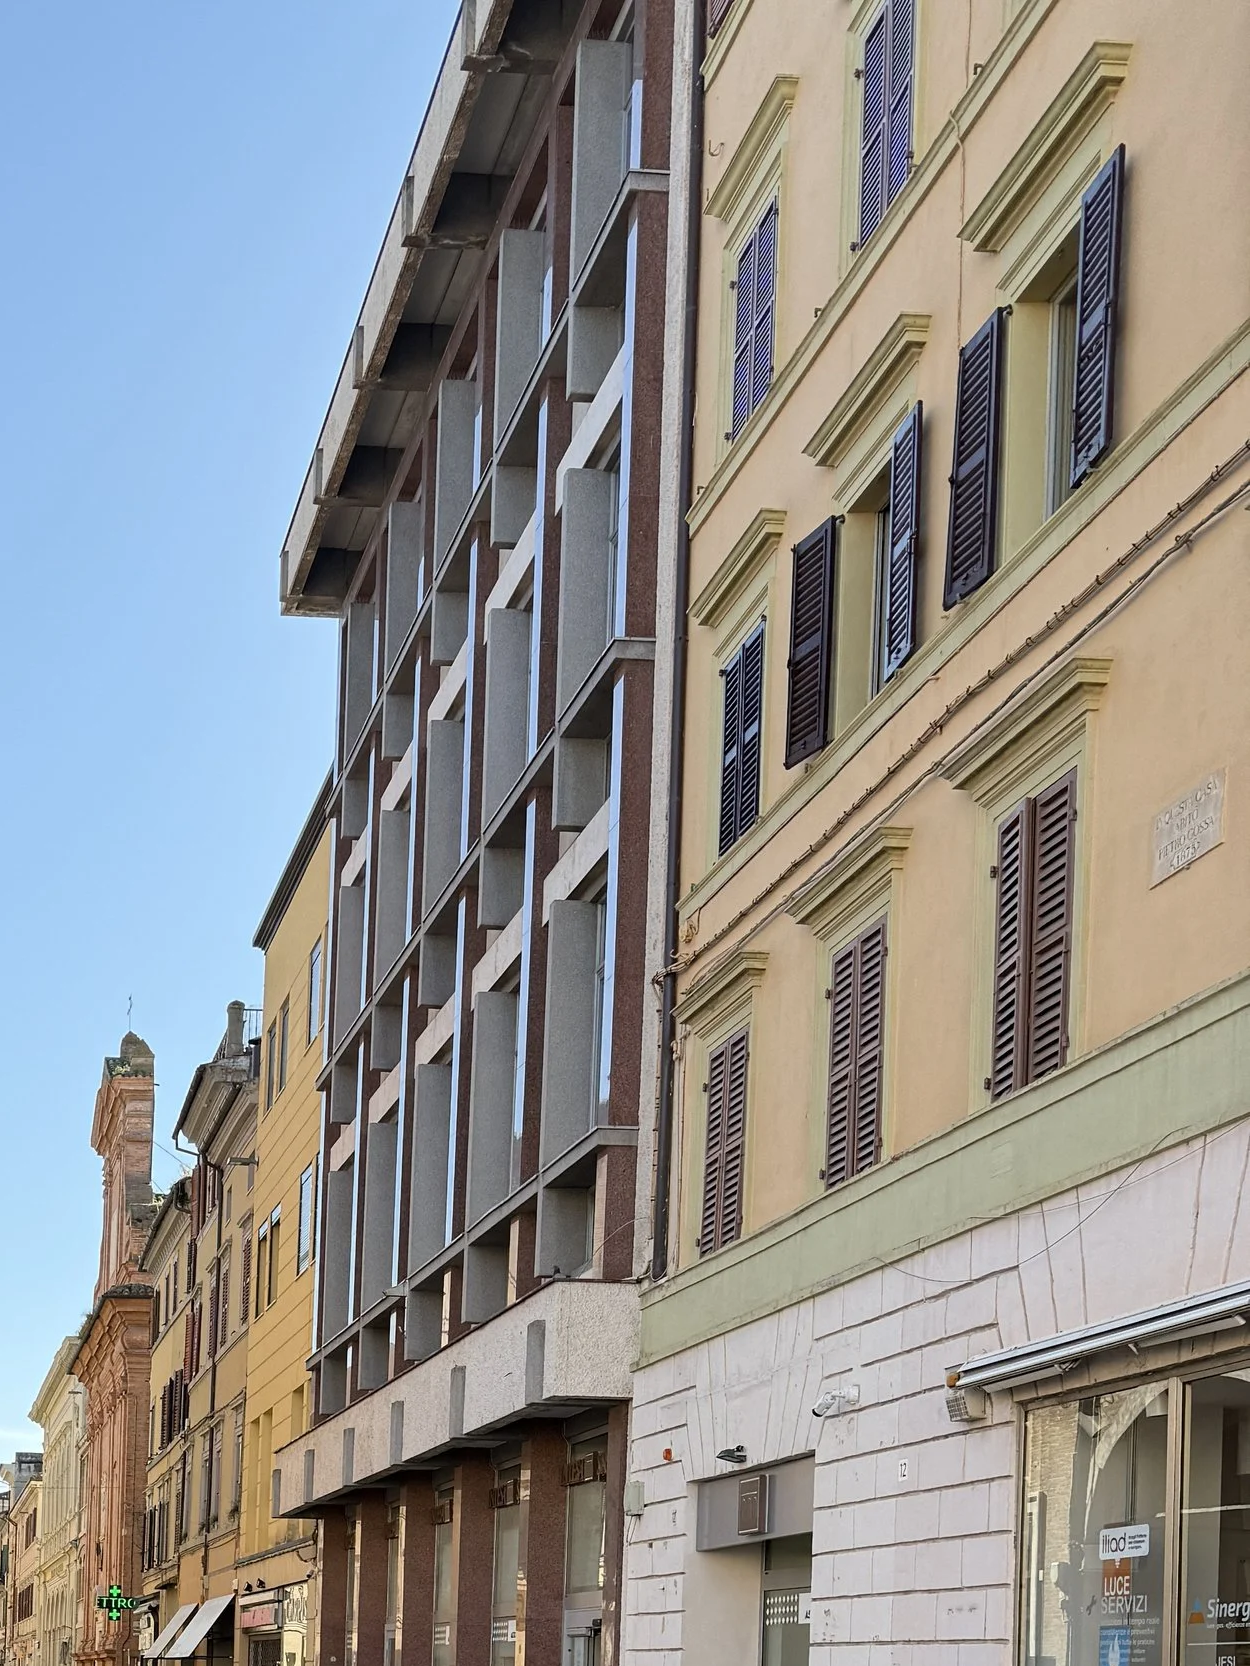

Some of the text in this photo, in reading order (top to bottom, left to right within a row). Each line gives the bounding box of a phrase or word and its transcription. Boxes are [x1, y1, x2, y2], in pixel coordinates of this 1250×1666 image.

[1101, 1532, 1127, 1554] iliad
[1104, 1575, 1130, 1596] LUCE
[1101, 1594, 1148, 1614] SERVIZI
